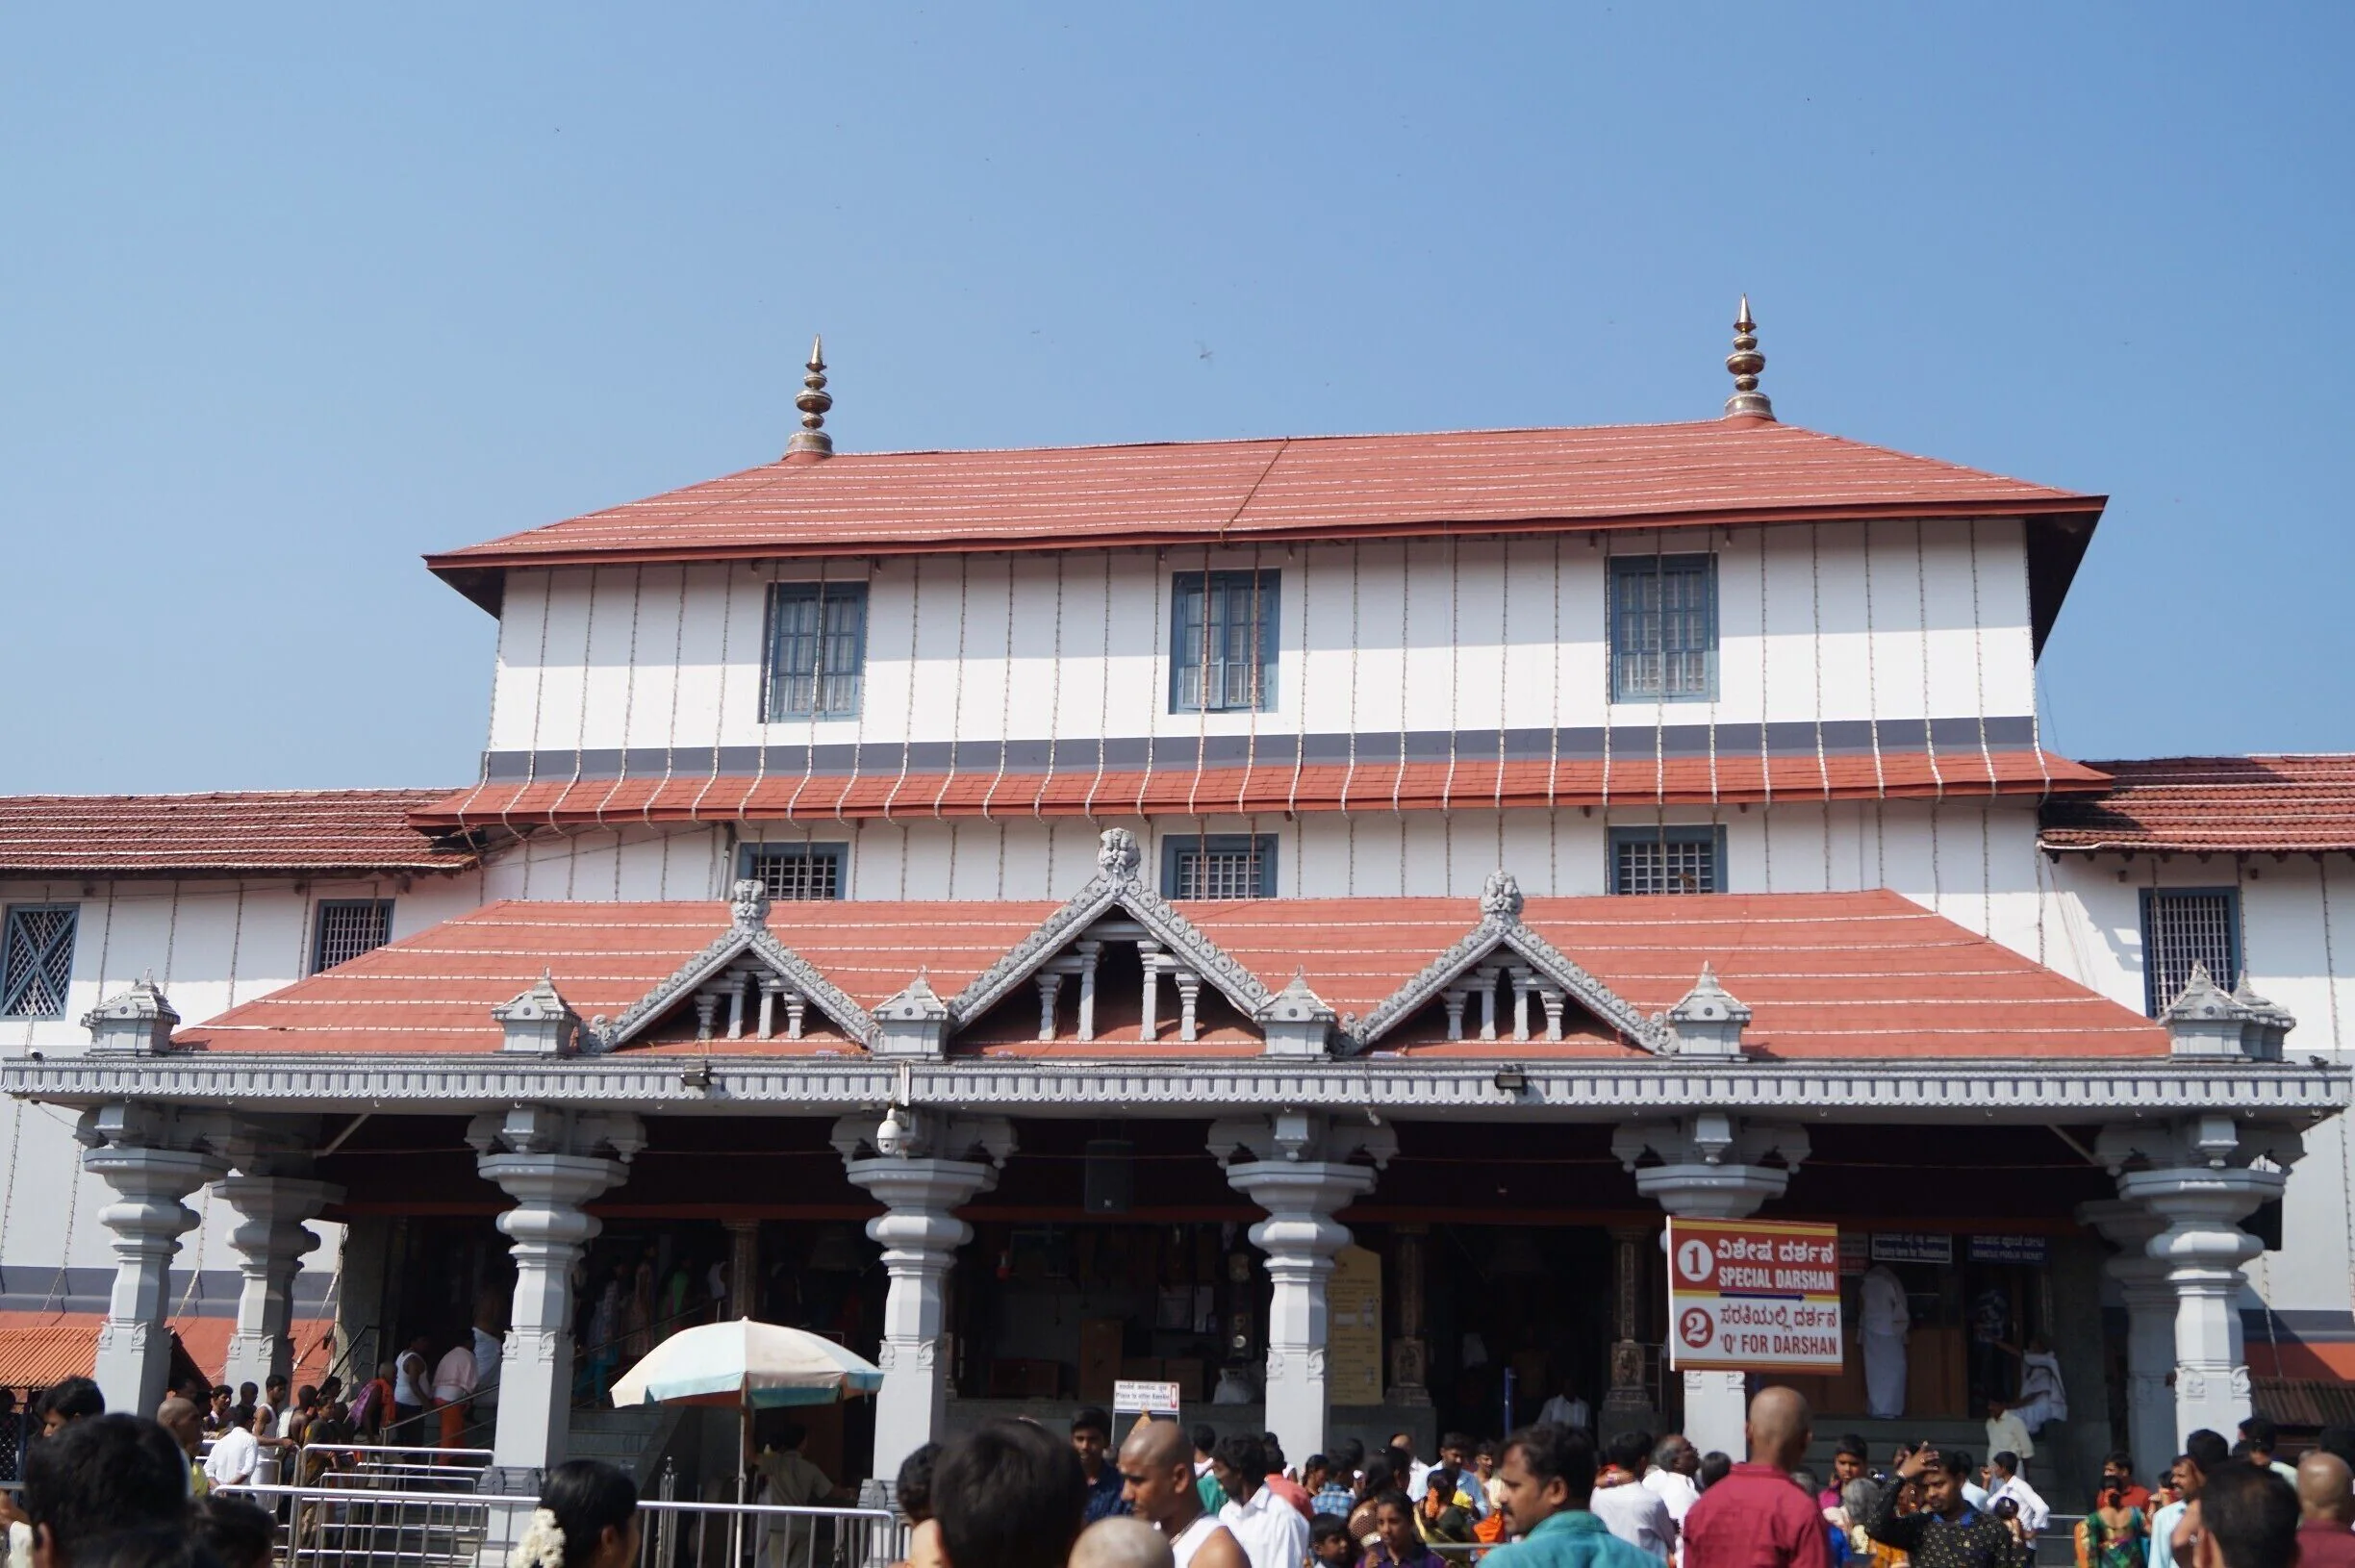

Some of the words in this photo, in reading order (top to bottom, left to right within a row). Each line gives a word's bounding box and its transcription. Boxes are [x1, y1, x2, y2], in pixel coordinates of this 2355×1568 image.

[1688, 1247, 1701, 1275] 1
[1716, 1237, 1774, 1262] ವಿಶೇಷ
[1779, 1239, 1835, 1264] ದರ್ಶನ
[1719, 1266, 1772, 1288] SPECIAL
[1775, 1269, 1835, 1291] DARSHAN
[1685, 1311, 1708, 1343] 2
[1720, 1303, 1793, 1331] ಸರತಿಯಲ್ಲಿ
[1793, 1305, 1836, 1328] ದರ್ಶನ
[1742, 1334, 1770, 1354] FOR
[1774, 1335, 1836, 1355] DARSHAN
